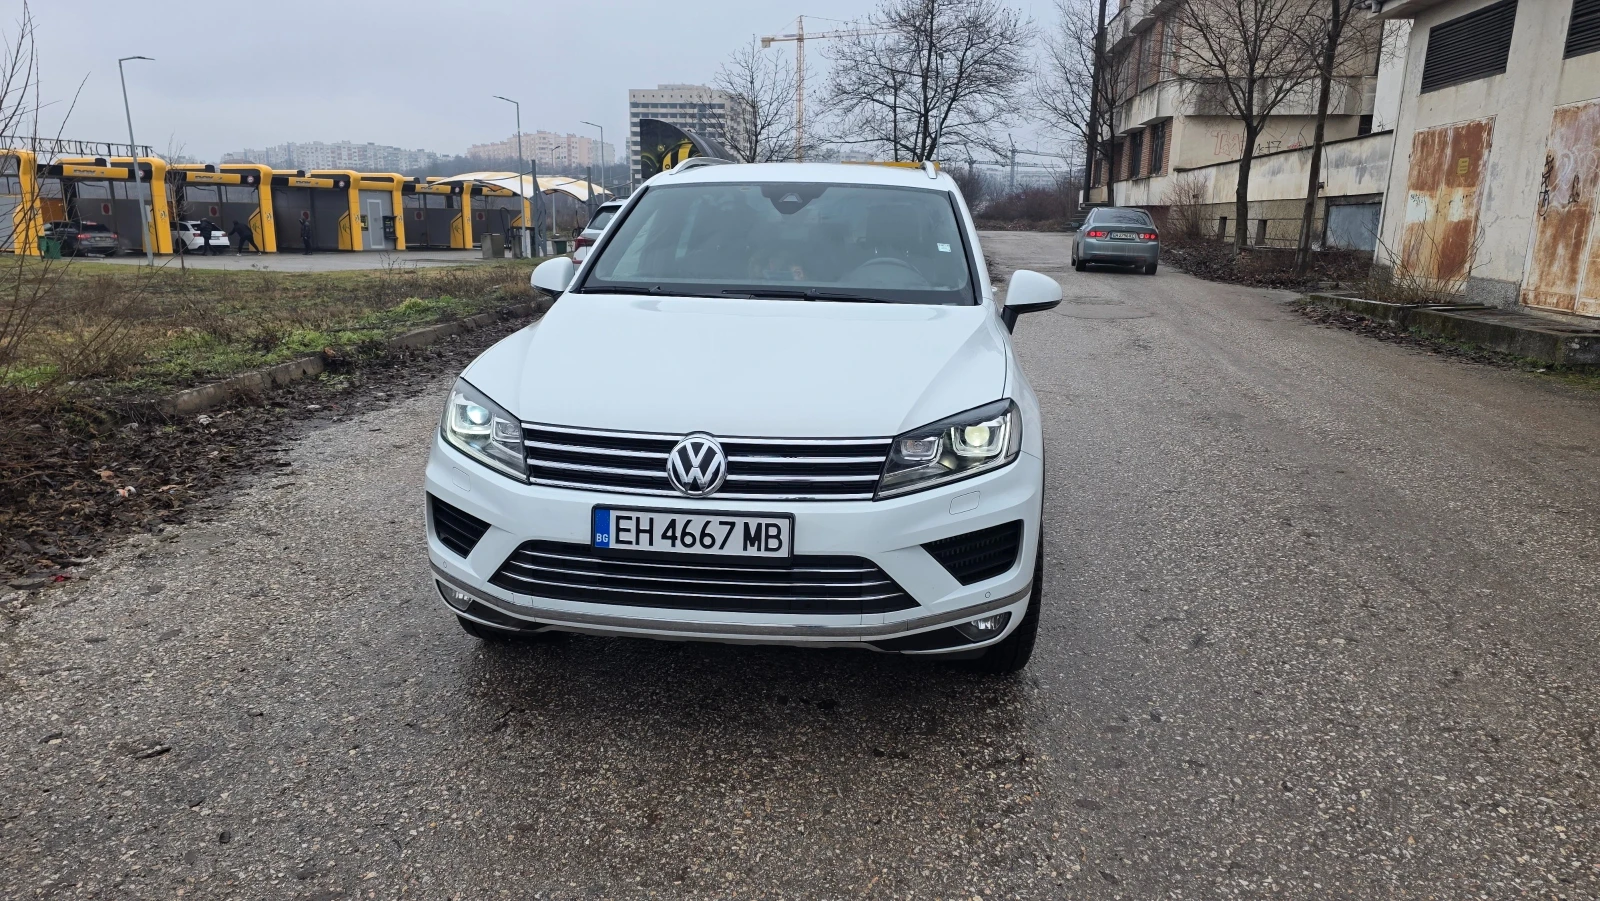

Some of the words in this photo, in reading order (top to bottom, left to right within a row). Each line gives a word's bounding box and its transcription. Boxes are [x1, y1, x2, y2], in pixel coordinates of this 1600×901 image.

[596, 533, 609, 543] BG
[615, 514, 654, 547] EH
[661, 518, 736, 550] 4667
[742, 521, 783, 552] MB
